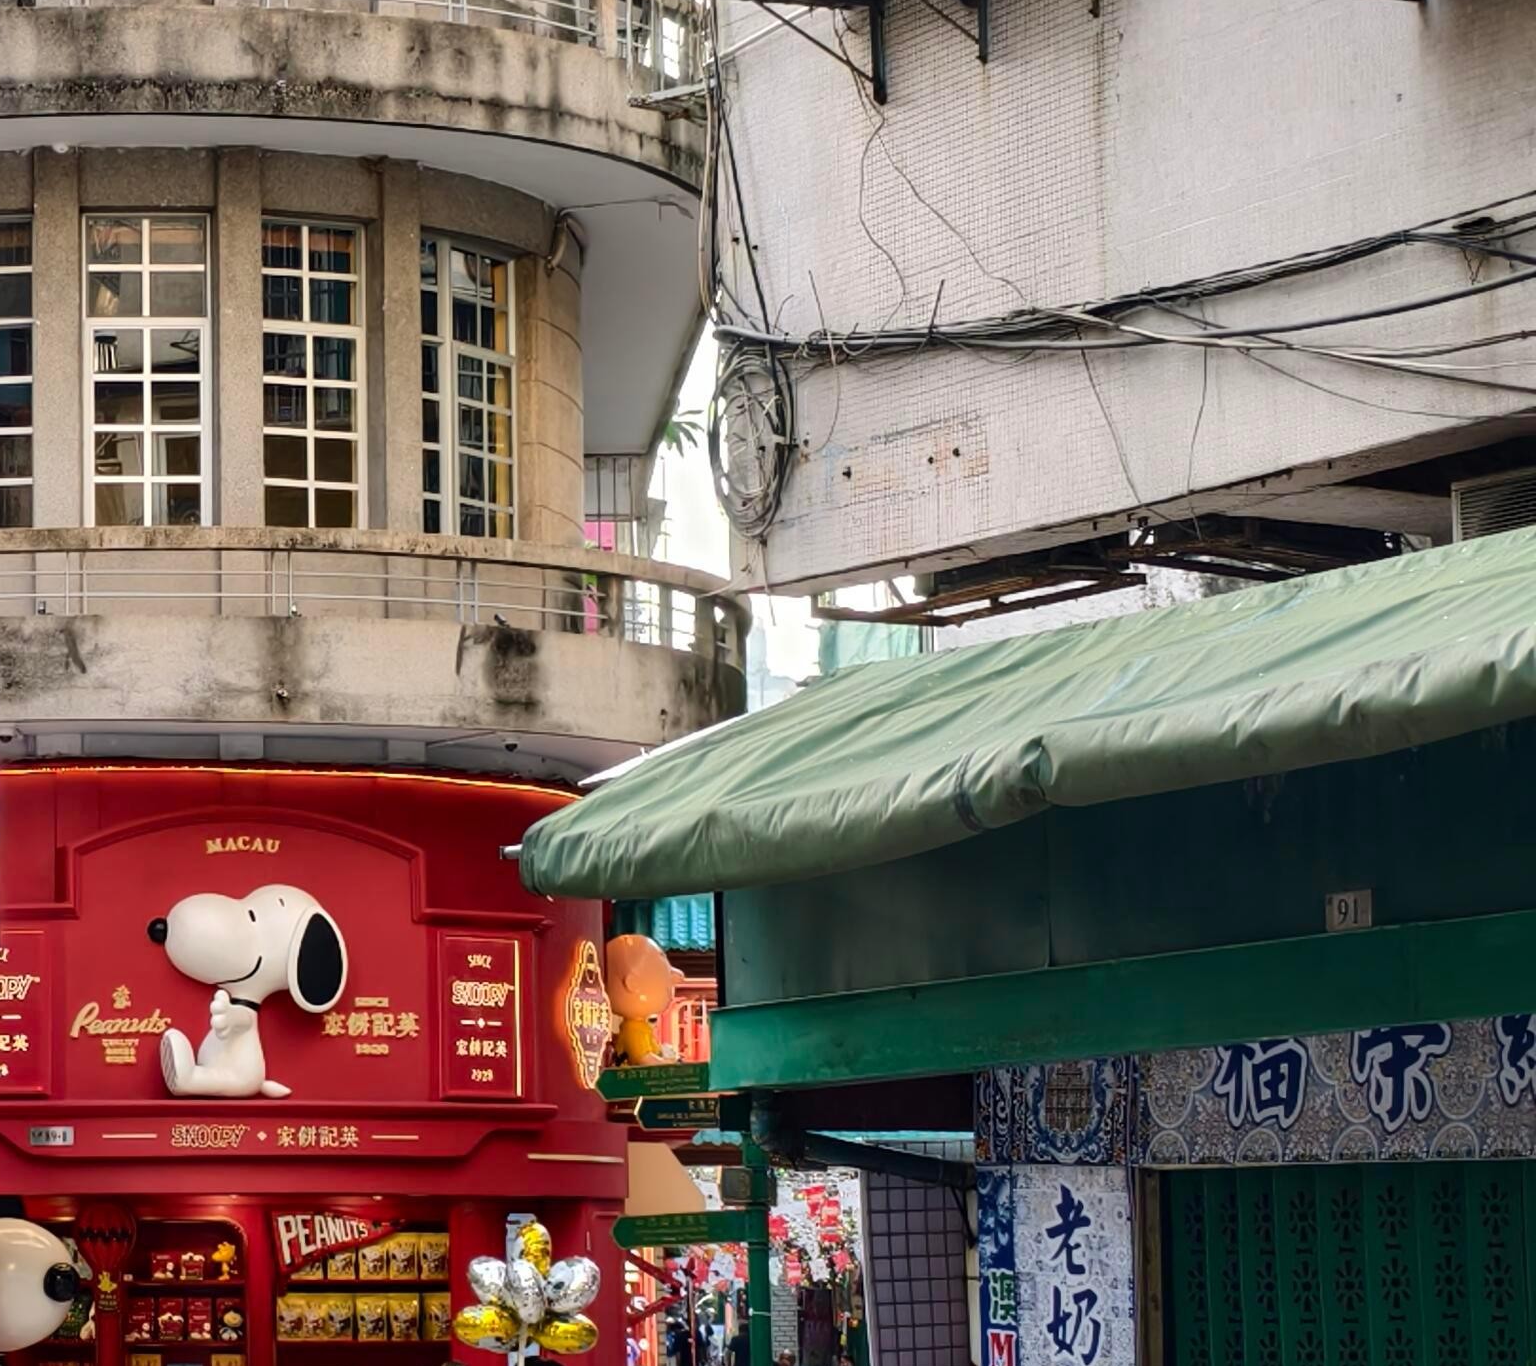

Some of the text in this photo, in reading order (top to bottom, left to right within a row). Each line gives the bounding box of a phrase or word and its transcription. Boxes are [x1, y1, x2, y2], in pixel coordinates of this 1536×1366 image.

[206, 835, 281, 855] MACAU
[1337, 897, 1359, 926] 91
[452, 980, 507, 1008] SNOOPY
[70, 1001, 172, 1039] Peanuts
[171, 1124, 247, 1148] SNOOPY
[277, 1214, 369, 1266] PEANUTS
